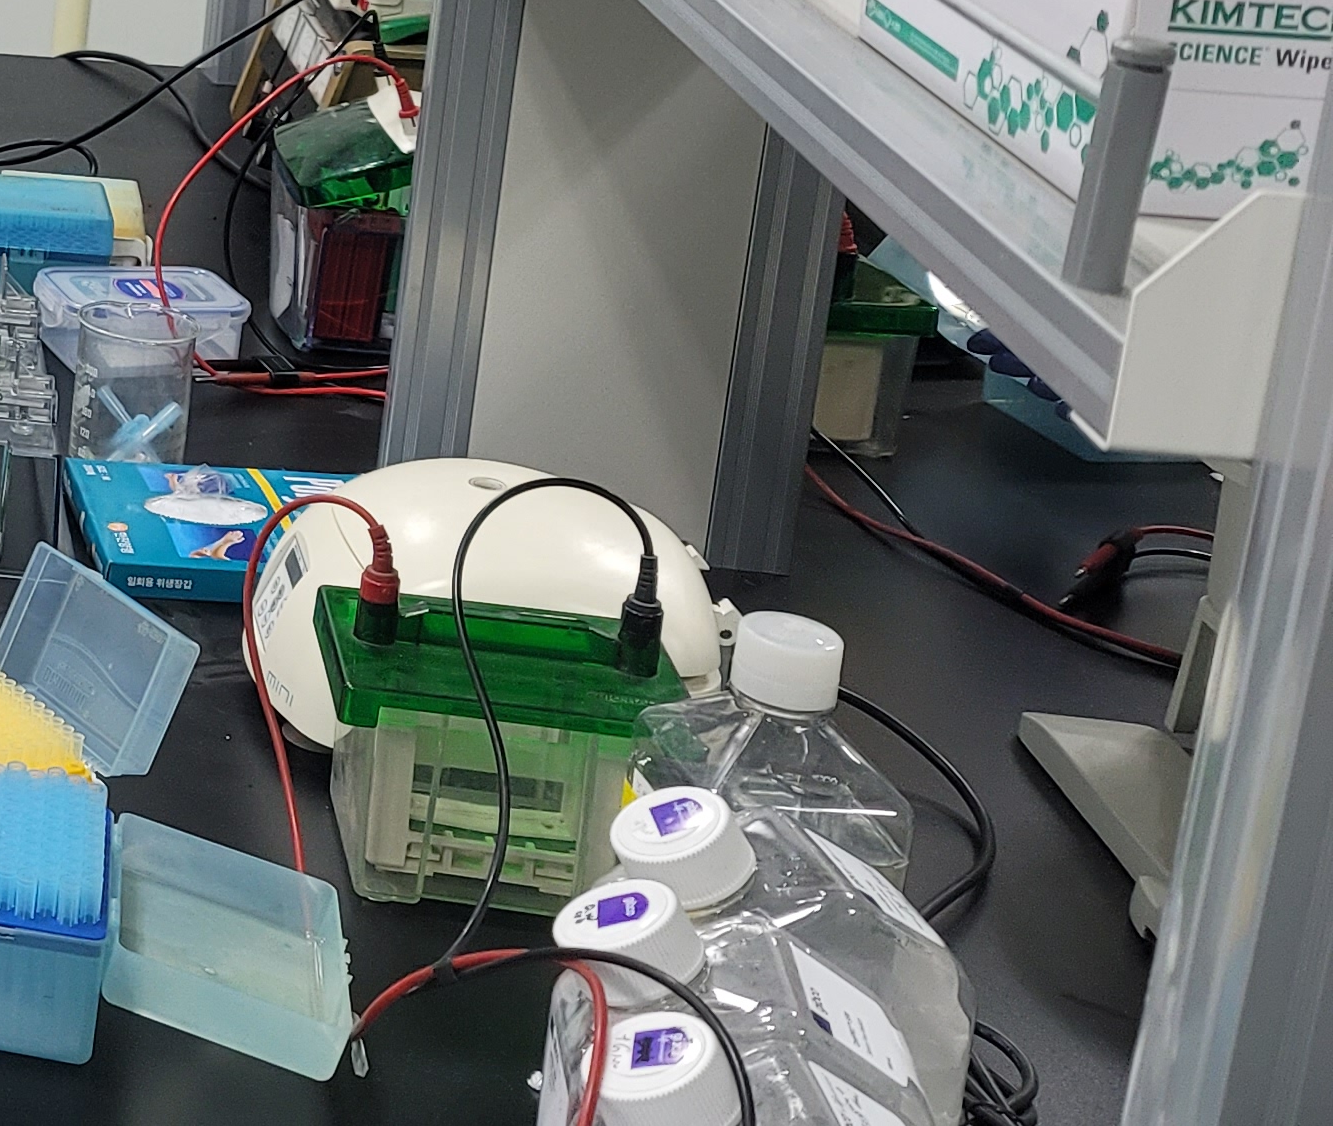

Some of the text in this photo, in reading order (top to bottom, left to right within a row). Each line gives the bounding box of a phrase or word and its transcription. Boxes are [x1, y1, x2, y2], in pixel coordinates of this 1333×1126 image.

[127, 576, 193, 590] 일회용 위생장갑
[266, 670, 294, 707] mini
